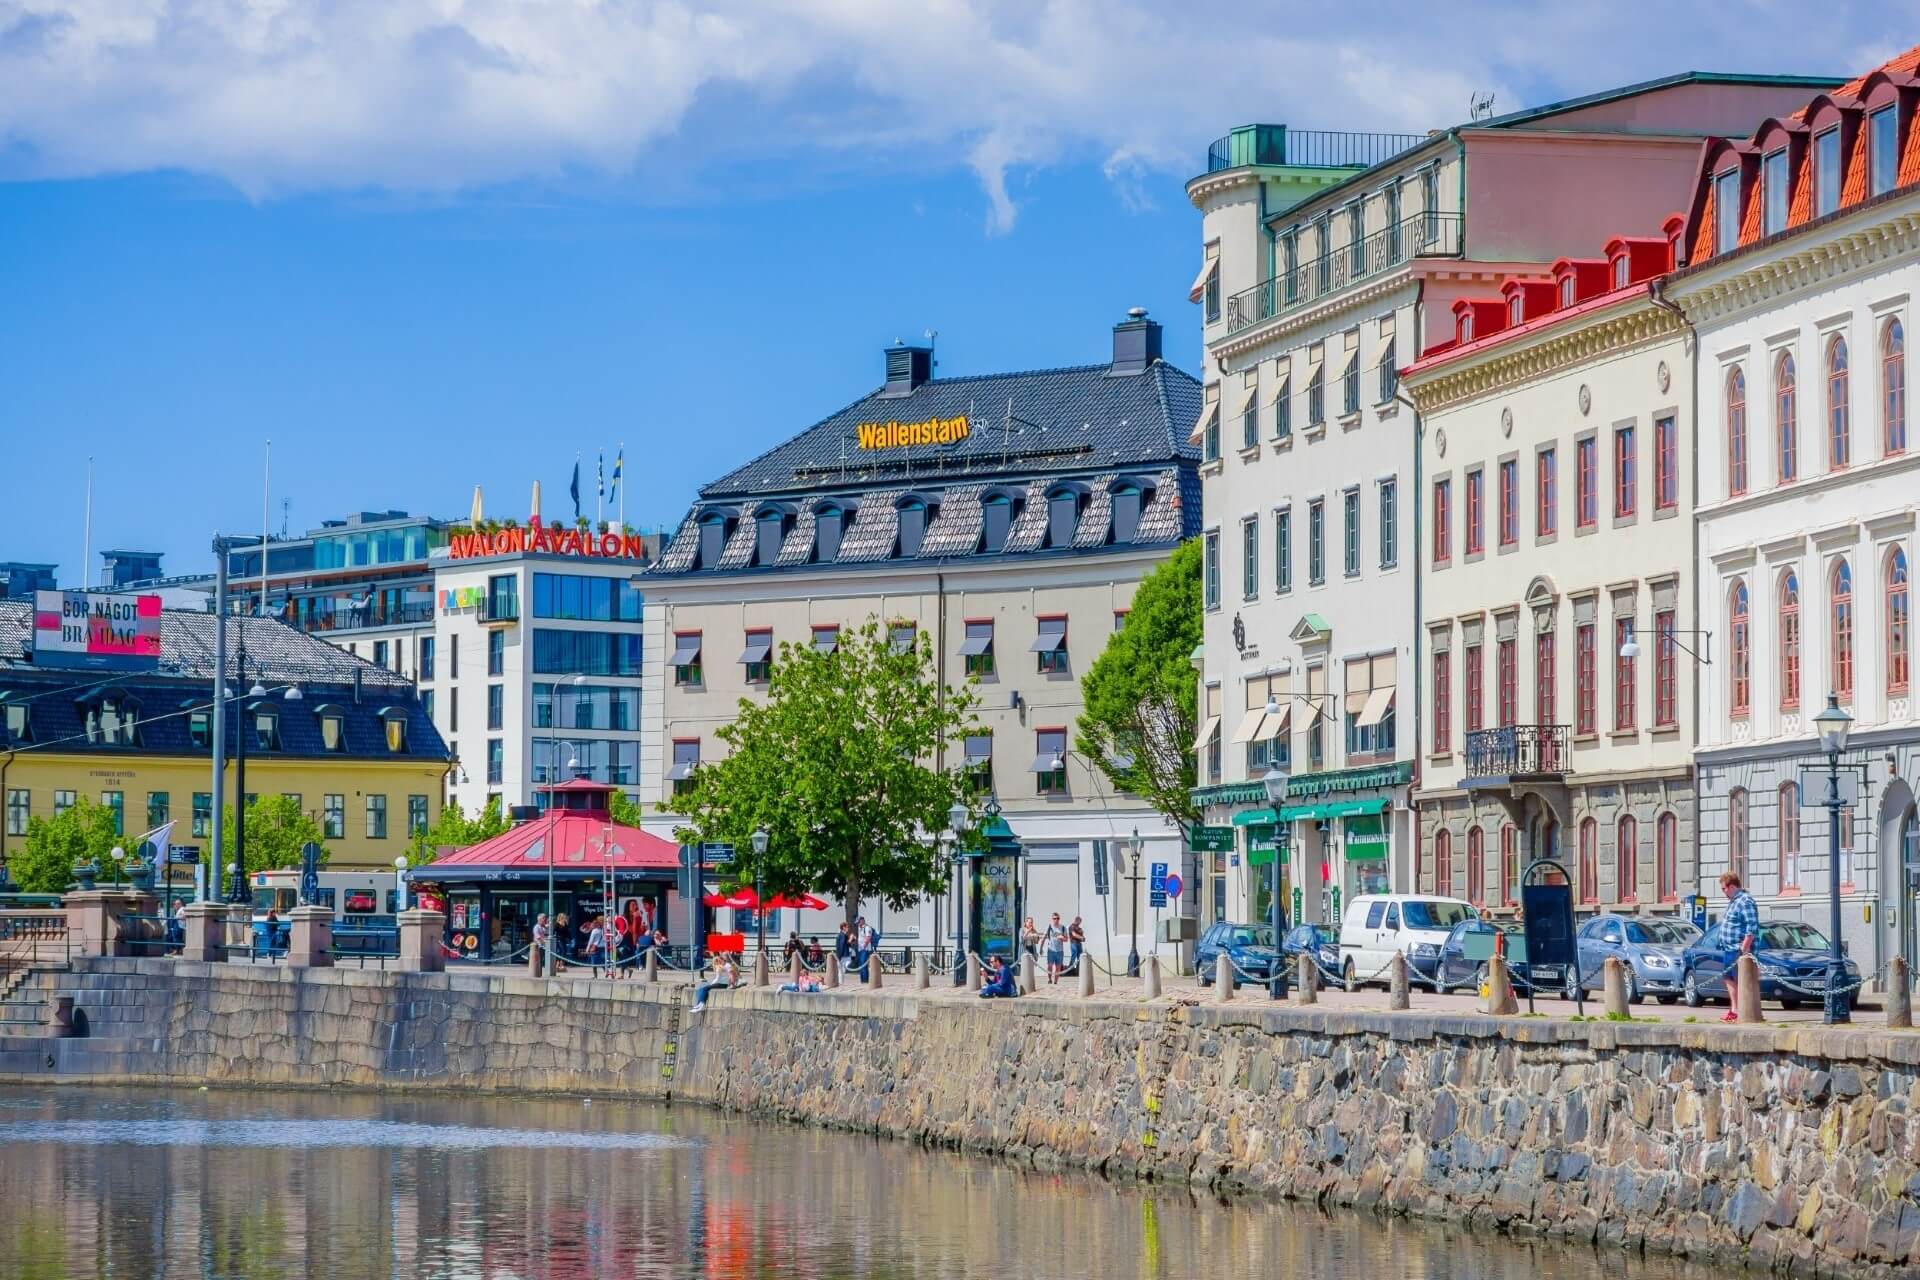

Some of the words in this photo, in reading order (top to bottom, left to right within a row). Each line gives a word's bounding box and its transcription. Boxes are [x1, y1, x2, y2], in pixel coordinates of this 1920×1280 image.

[857, 415, 969, 449] Wallenstam
[448, 528, 525, 560] AVALON
[528, 526, 642, 560] AVALON
[63, 597, 90, 619] GÖR
[95, 597, 138, 621] NÅGOT
[62, 625, 93, 643] BRA
[100, 628, 136, 648] IDAG
[984, 865, 1011, 876] LOKA
[1156, 864, 1164, 876] P
[1694, 904, 1704, 918] P
